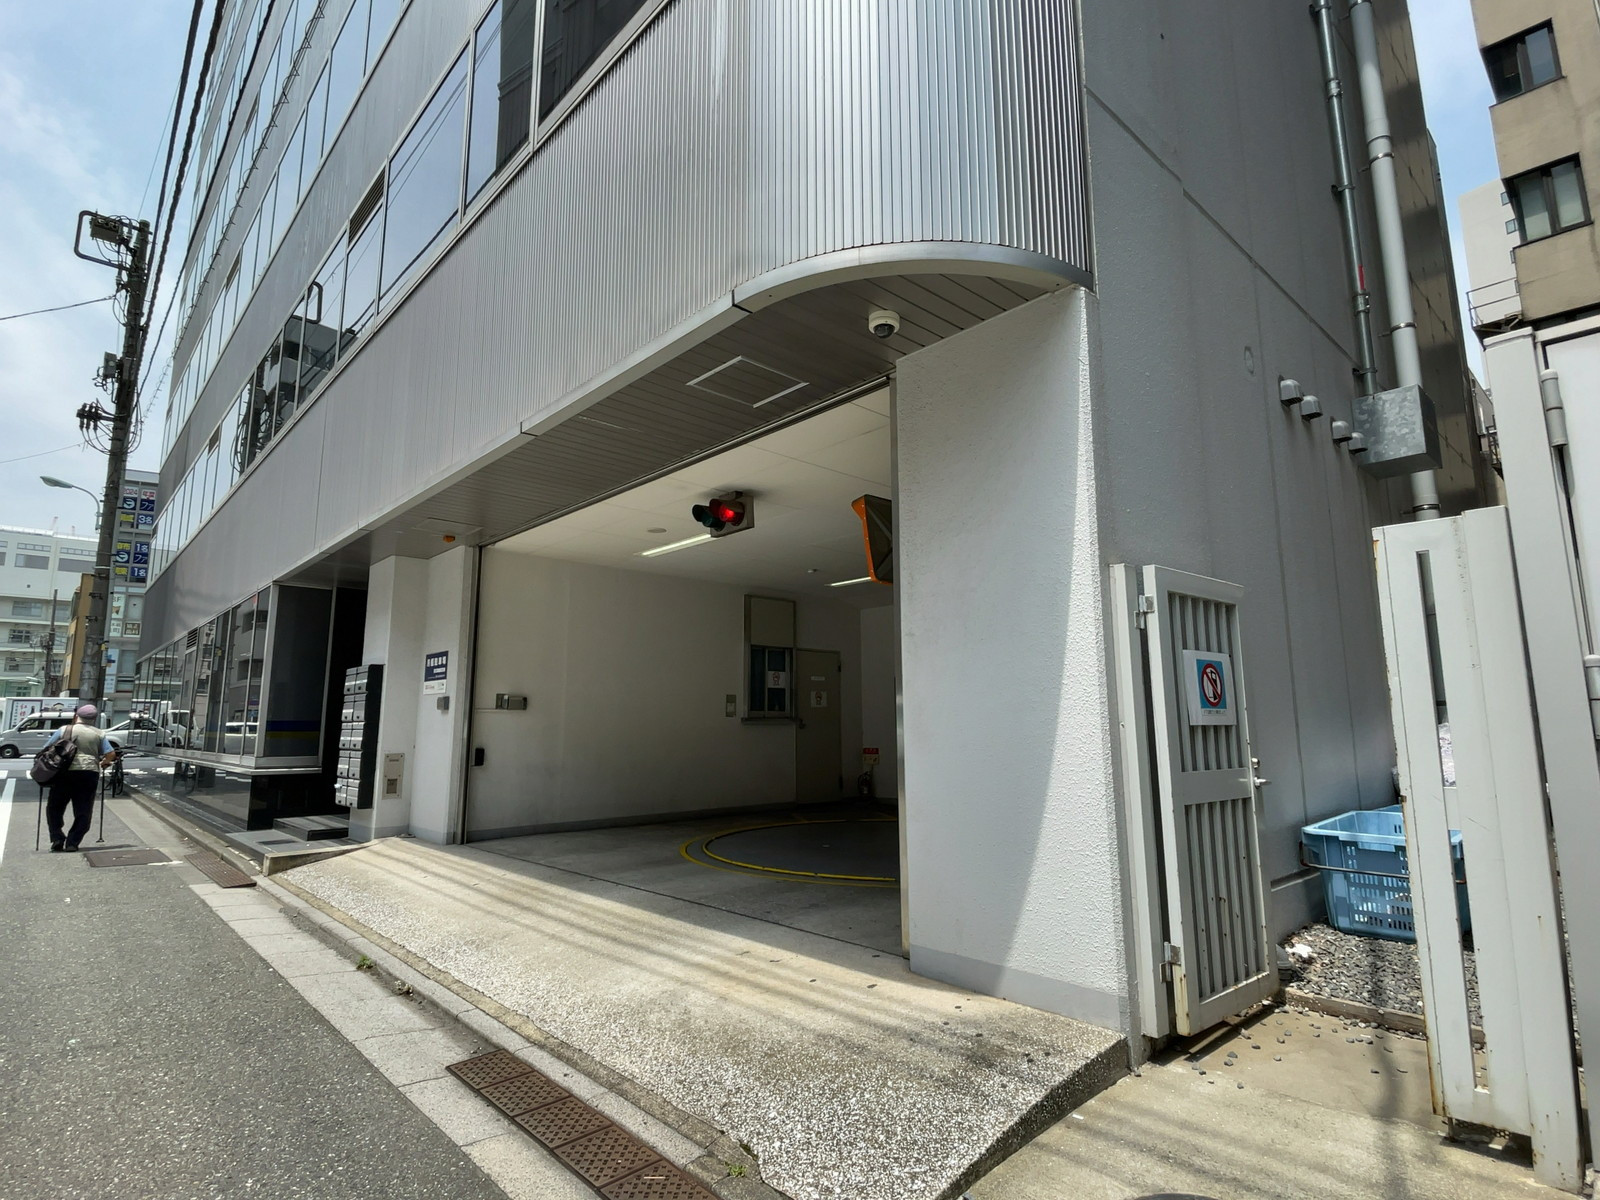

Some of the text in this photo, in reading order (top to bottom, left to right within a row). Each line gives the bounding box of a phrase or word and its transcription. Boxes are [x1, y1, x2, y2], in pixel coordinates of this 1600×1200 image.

[138, 515, 152, 524] 3名
[136, 543, 149, 553] 1名
[134, 567, 146, 577] 1名
